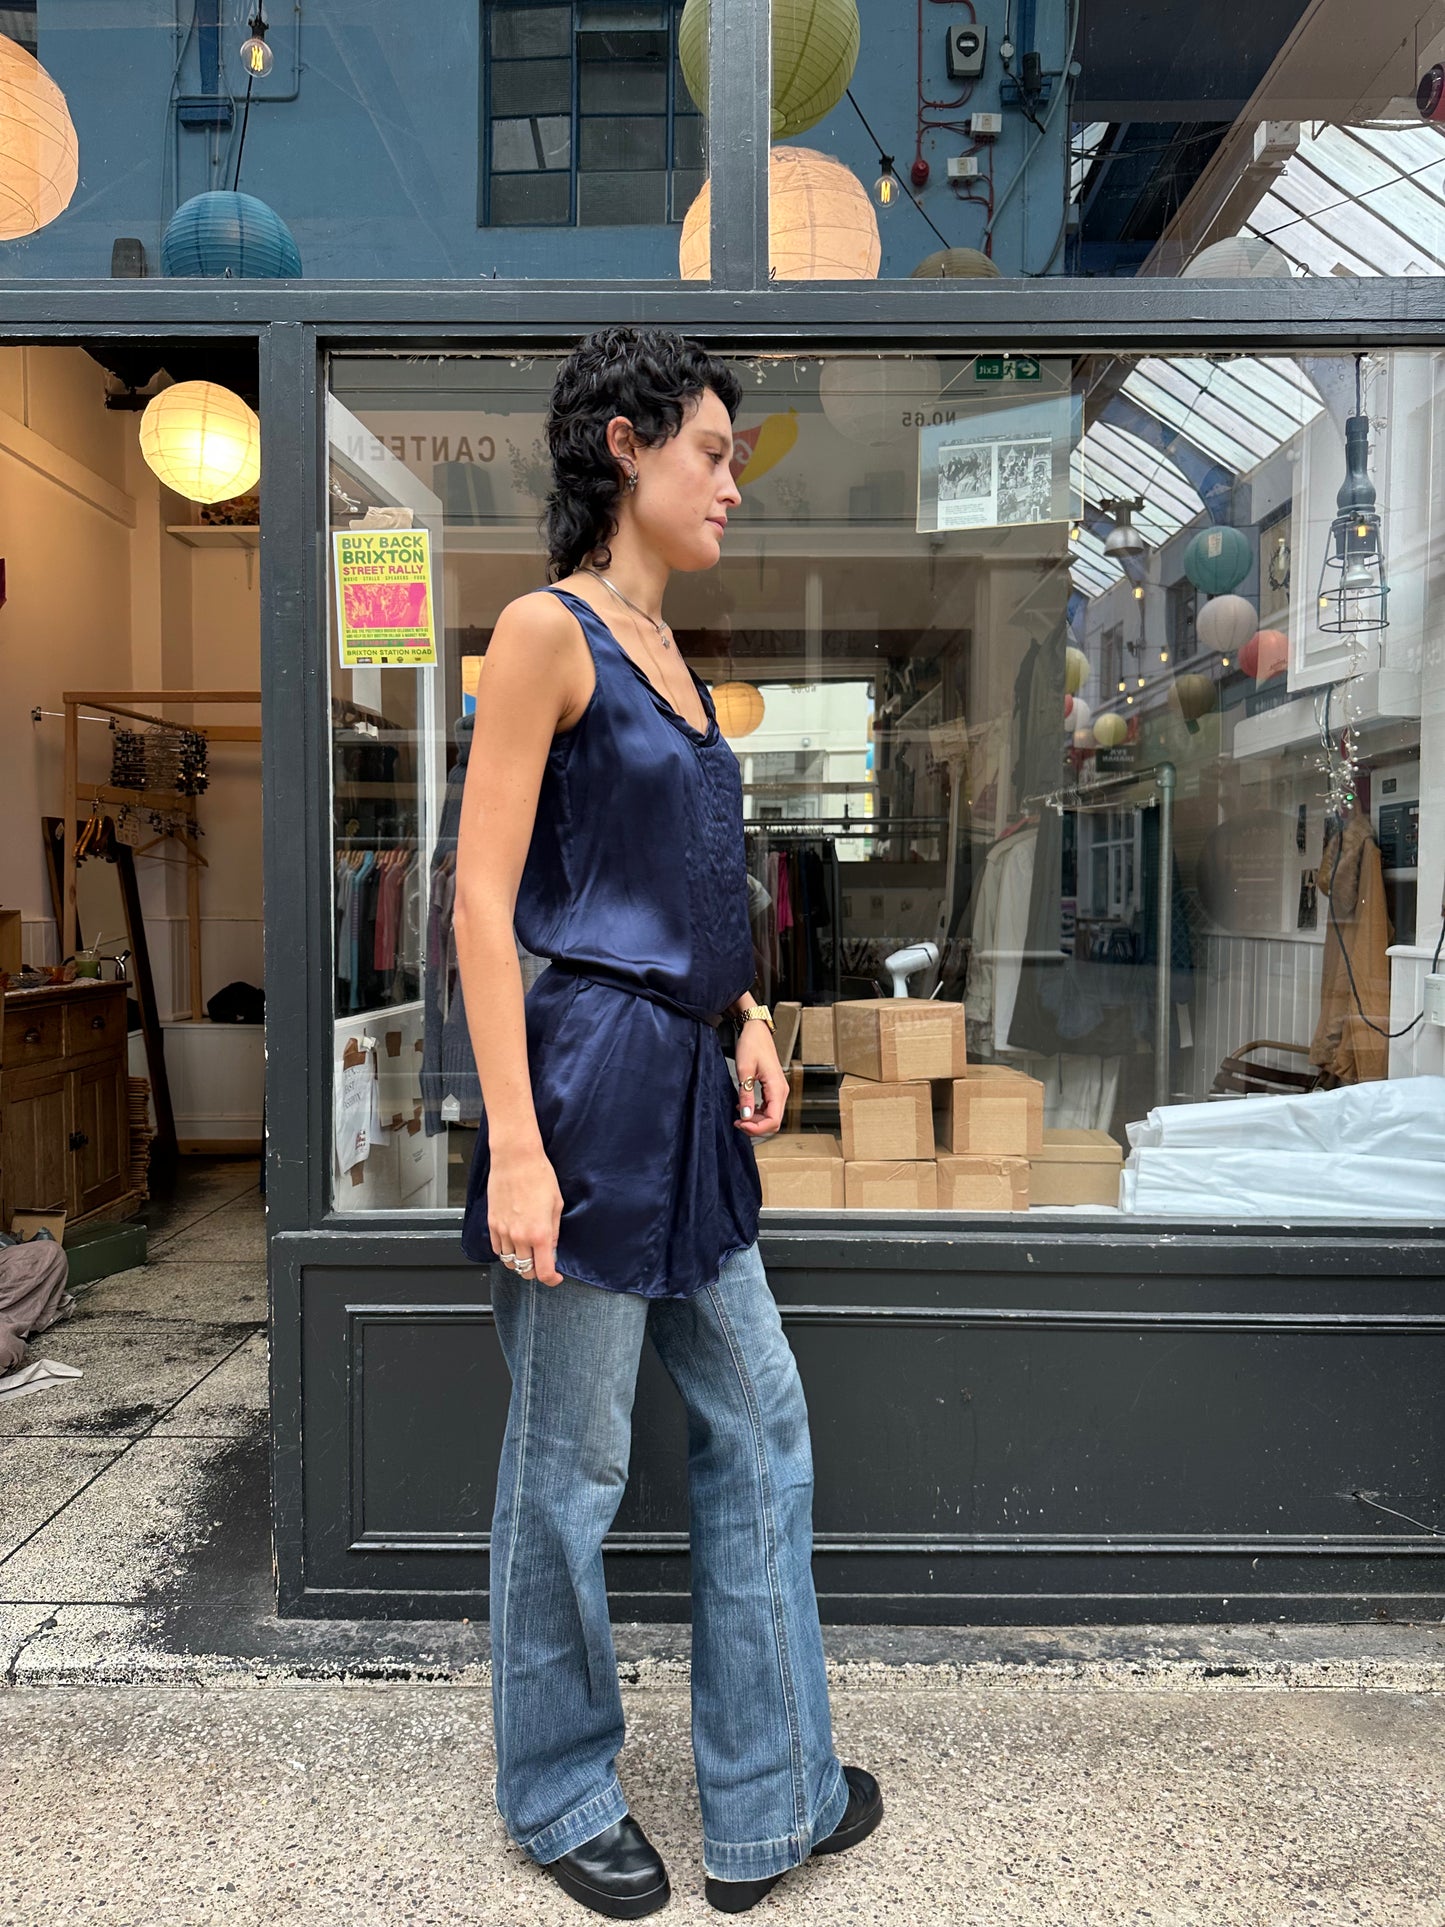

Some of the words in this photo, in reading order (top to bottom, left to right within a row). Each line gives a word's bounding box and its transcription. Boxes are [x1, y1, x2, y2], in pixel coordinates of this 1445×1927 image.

[342, 537, 374, 550] BUY
[379, 536, 423, 549] BACK
[343, 549, 424, 565] BRIXTON
[343, 566, 385, 576] STREET
[389, 565, 424, 575] RALLY
